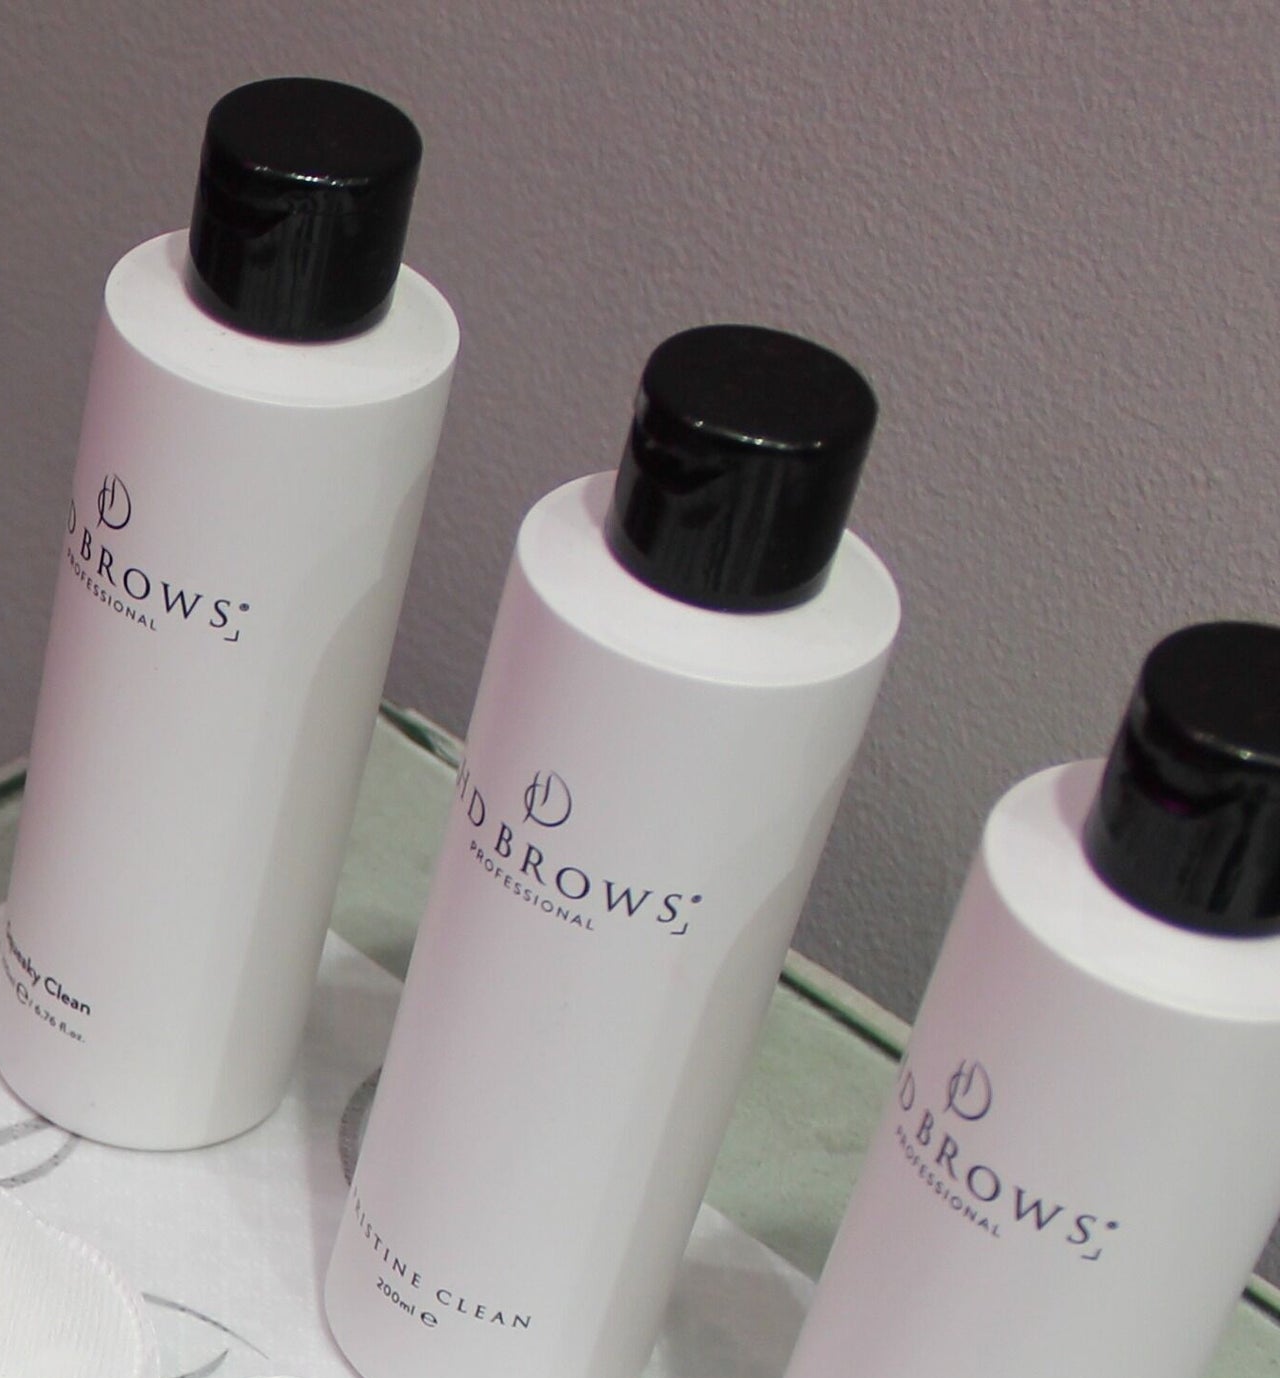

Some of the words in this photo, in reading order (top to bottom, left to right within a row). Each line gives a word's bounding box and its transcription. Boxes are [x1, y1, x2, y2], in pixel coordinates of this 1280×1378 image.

[66, 547, 158, 632] PROFESSIONAL
[469, 839, 595, 931] PROFESSIONAL
[43, 976, 92, 1016] Clean
[895, 1124, 1001, 1238] PROFESSIONAL
[376, 1276, 416, 1316] 200ml
[435, 1288, 532, 1329] CLEAN
